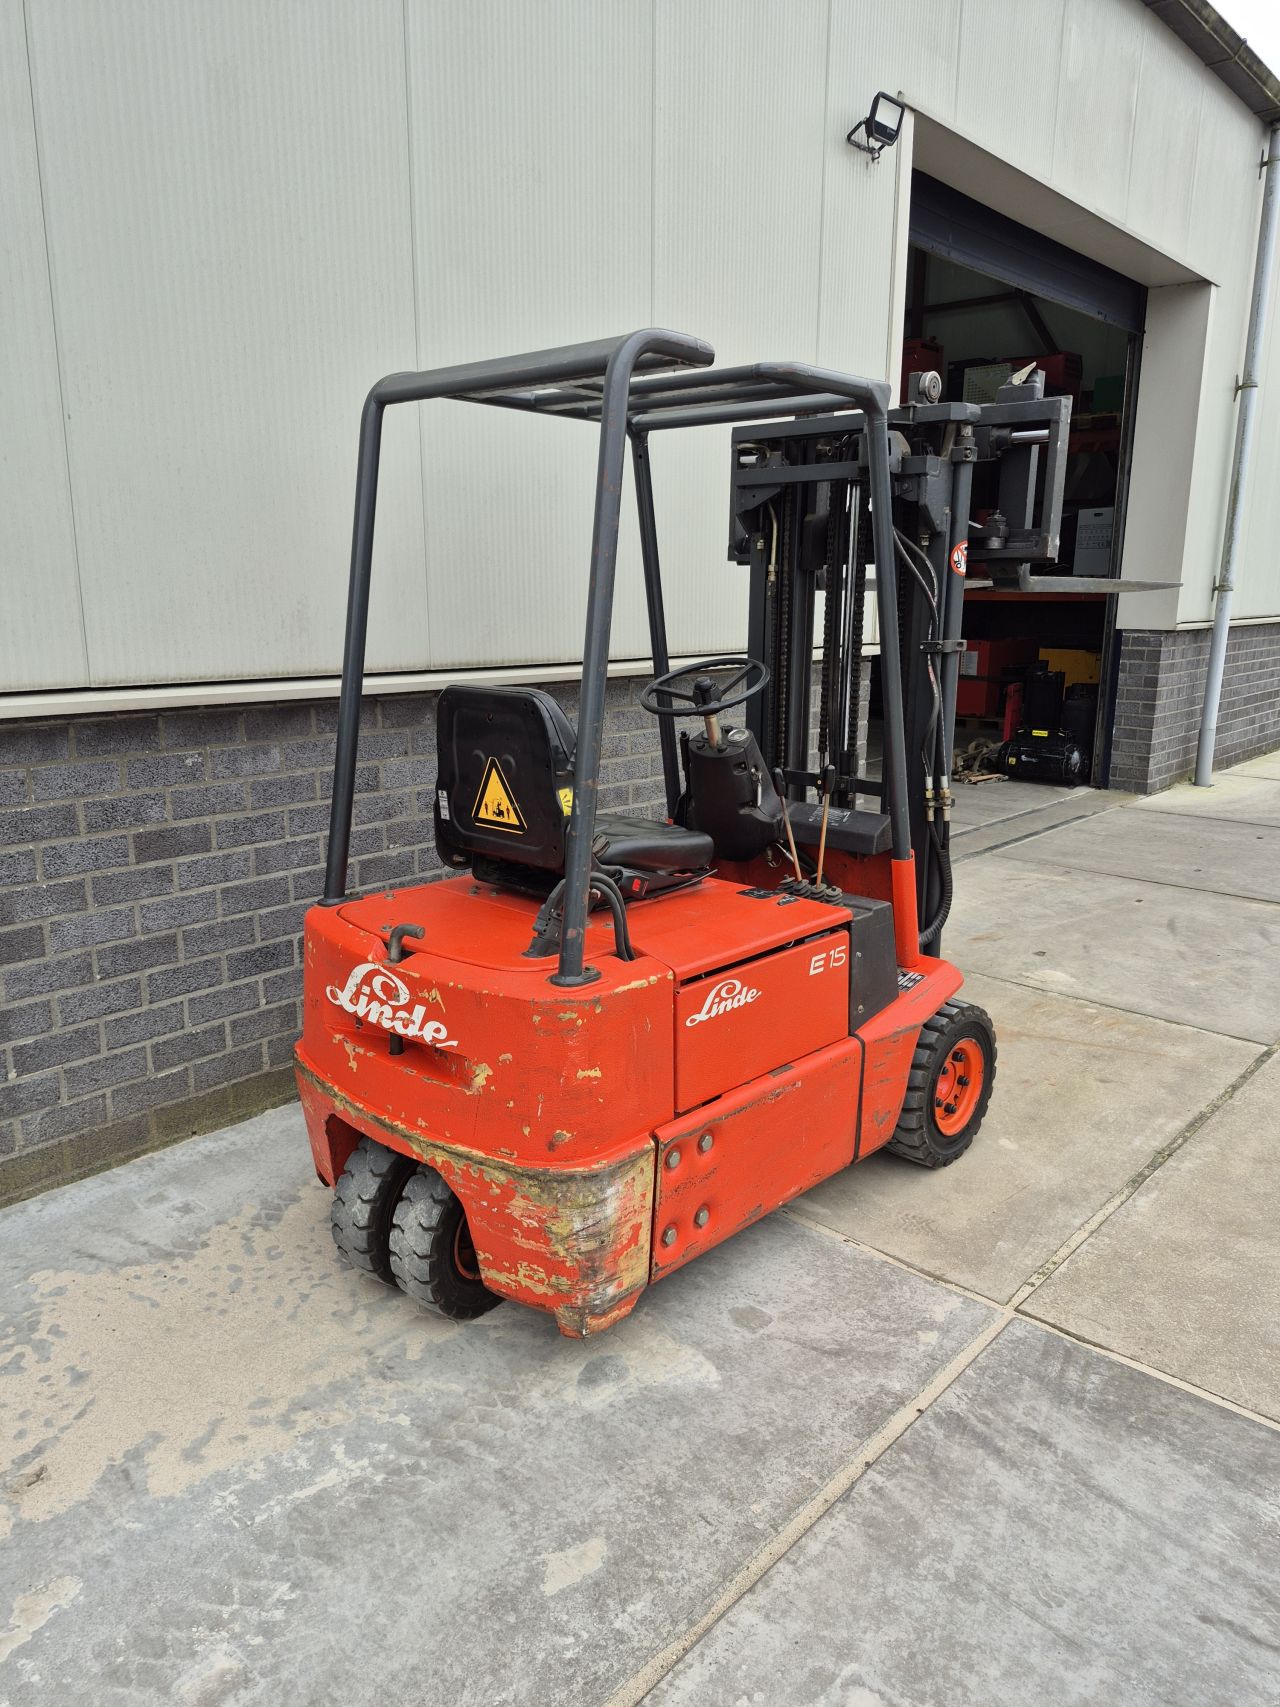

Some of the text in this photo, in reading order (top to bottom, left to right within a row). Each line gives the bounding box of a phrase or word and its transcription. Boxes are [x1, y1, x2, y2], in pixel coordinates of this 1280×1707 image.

[809, 946, 847, 976] E 15
[326, 963, 458, 1047] Linde
[686, 980, 762, 1027] Linde
